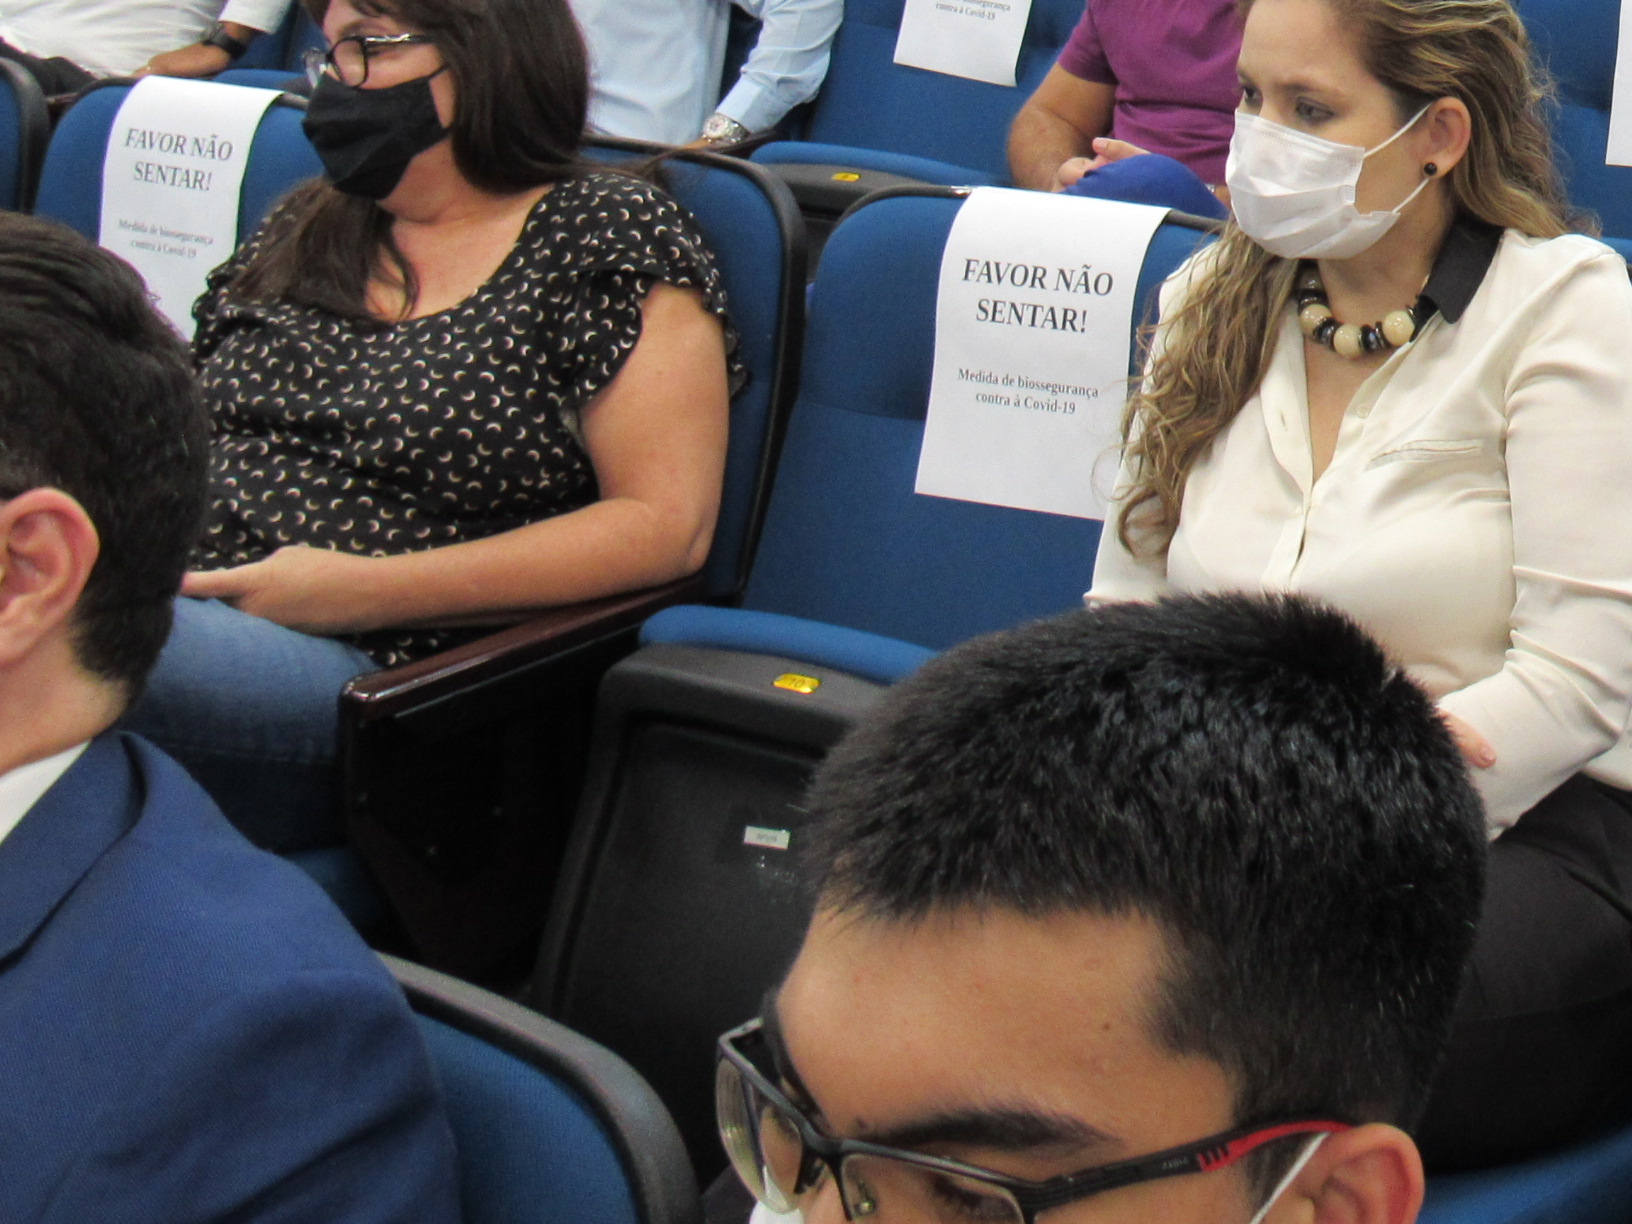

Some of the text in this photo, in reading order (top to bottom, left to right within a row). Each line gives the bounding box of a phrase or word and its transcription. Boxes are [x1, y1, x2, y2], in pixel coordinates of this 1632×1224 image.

[124, 128, 233, 161] FAVOR NÃO
[133, 161, 212, 191] SENTAR!
[962, 258, 1113, 296] FAVOR NÃO
[976, 299, 1088, 333] SENTAR!
[958, 367, 1099, 399] Medida de biossegurança
[976, 391, 1076, 414] contra à Covid-19
